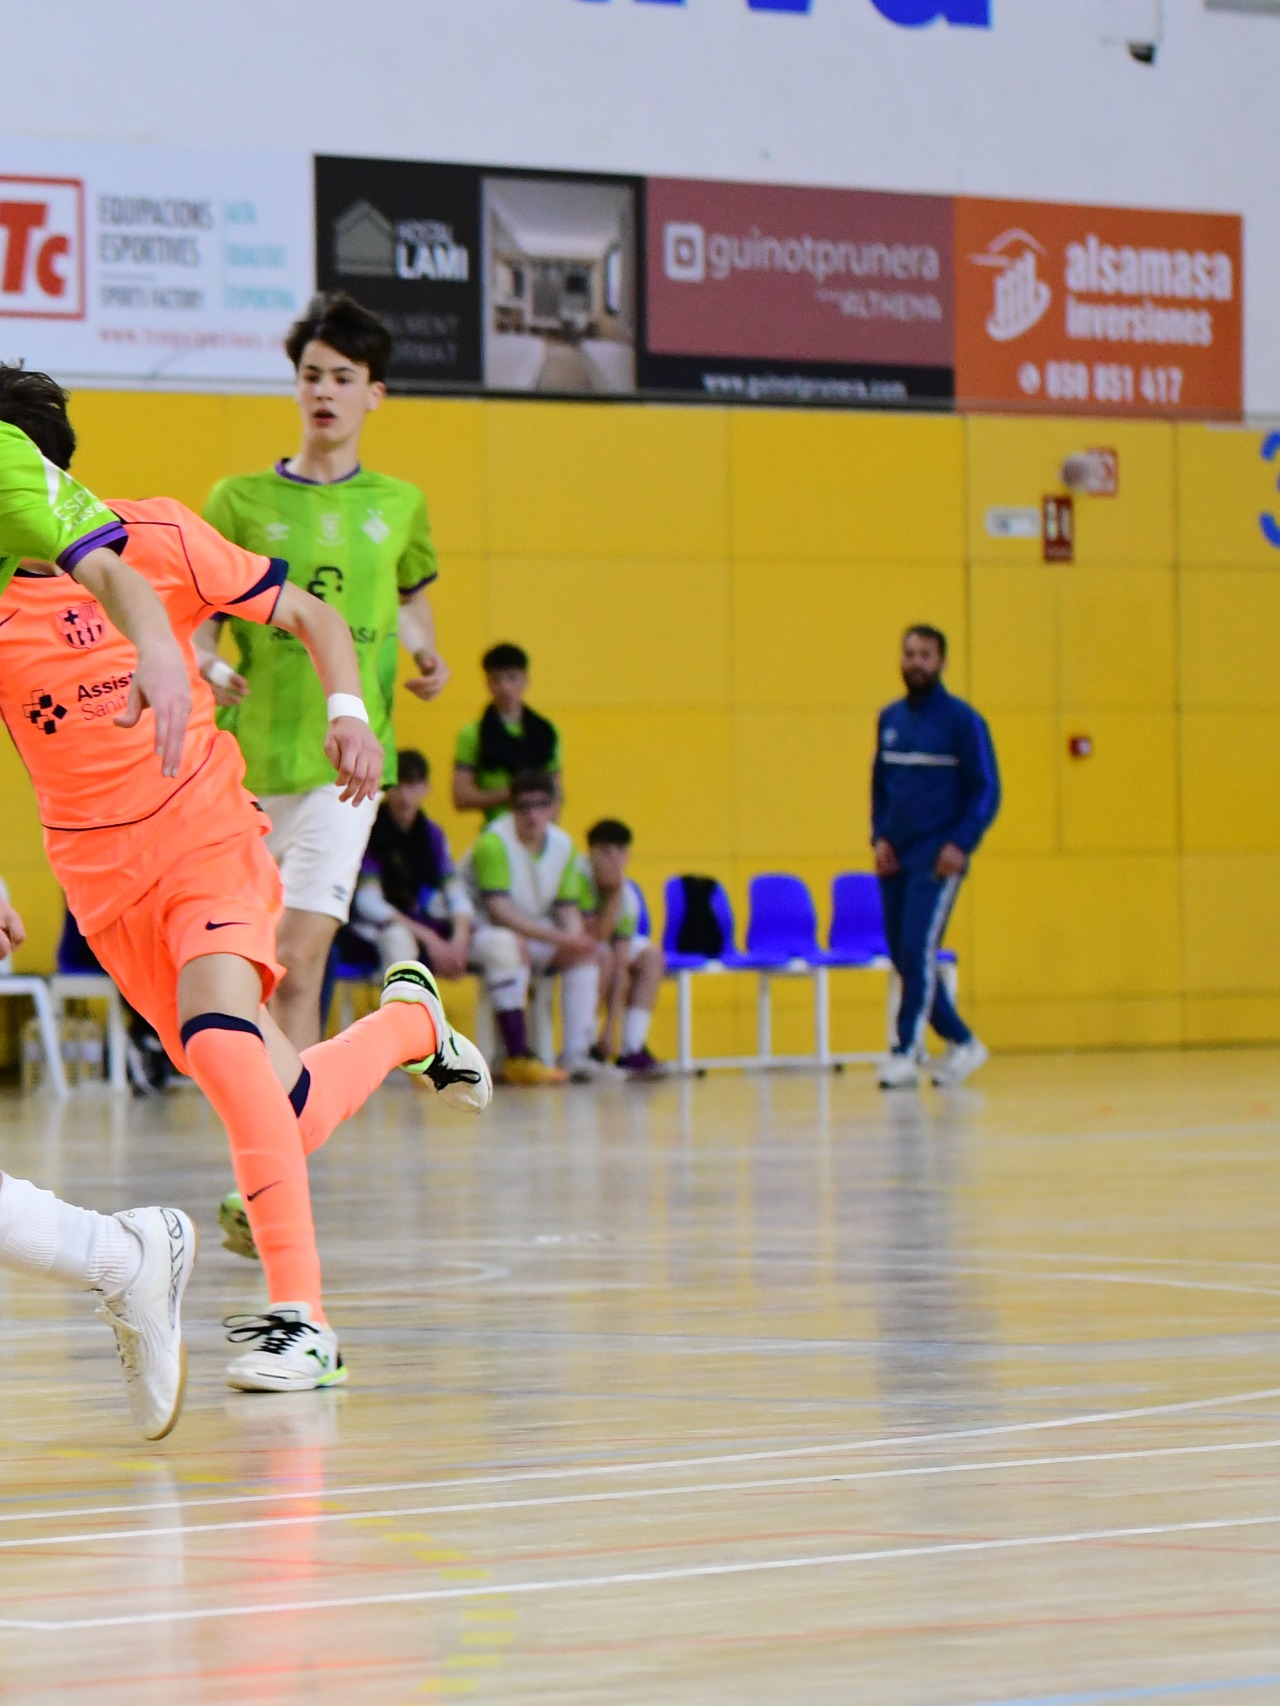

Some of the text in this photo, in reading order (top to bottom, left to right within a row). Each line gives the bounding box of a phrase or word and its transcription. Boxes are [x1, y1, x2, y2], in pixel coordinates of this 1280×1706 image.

[99, 196, 214, 232] EQUIPACIONS
[99, 233, 201, 269] ESPORTIVES
[395, 243, 469, 283] LAMI
[709, 227, 940, 284] guinotprunera
[1066, 234, 1233, 301] alsamasa
